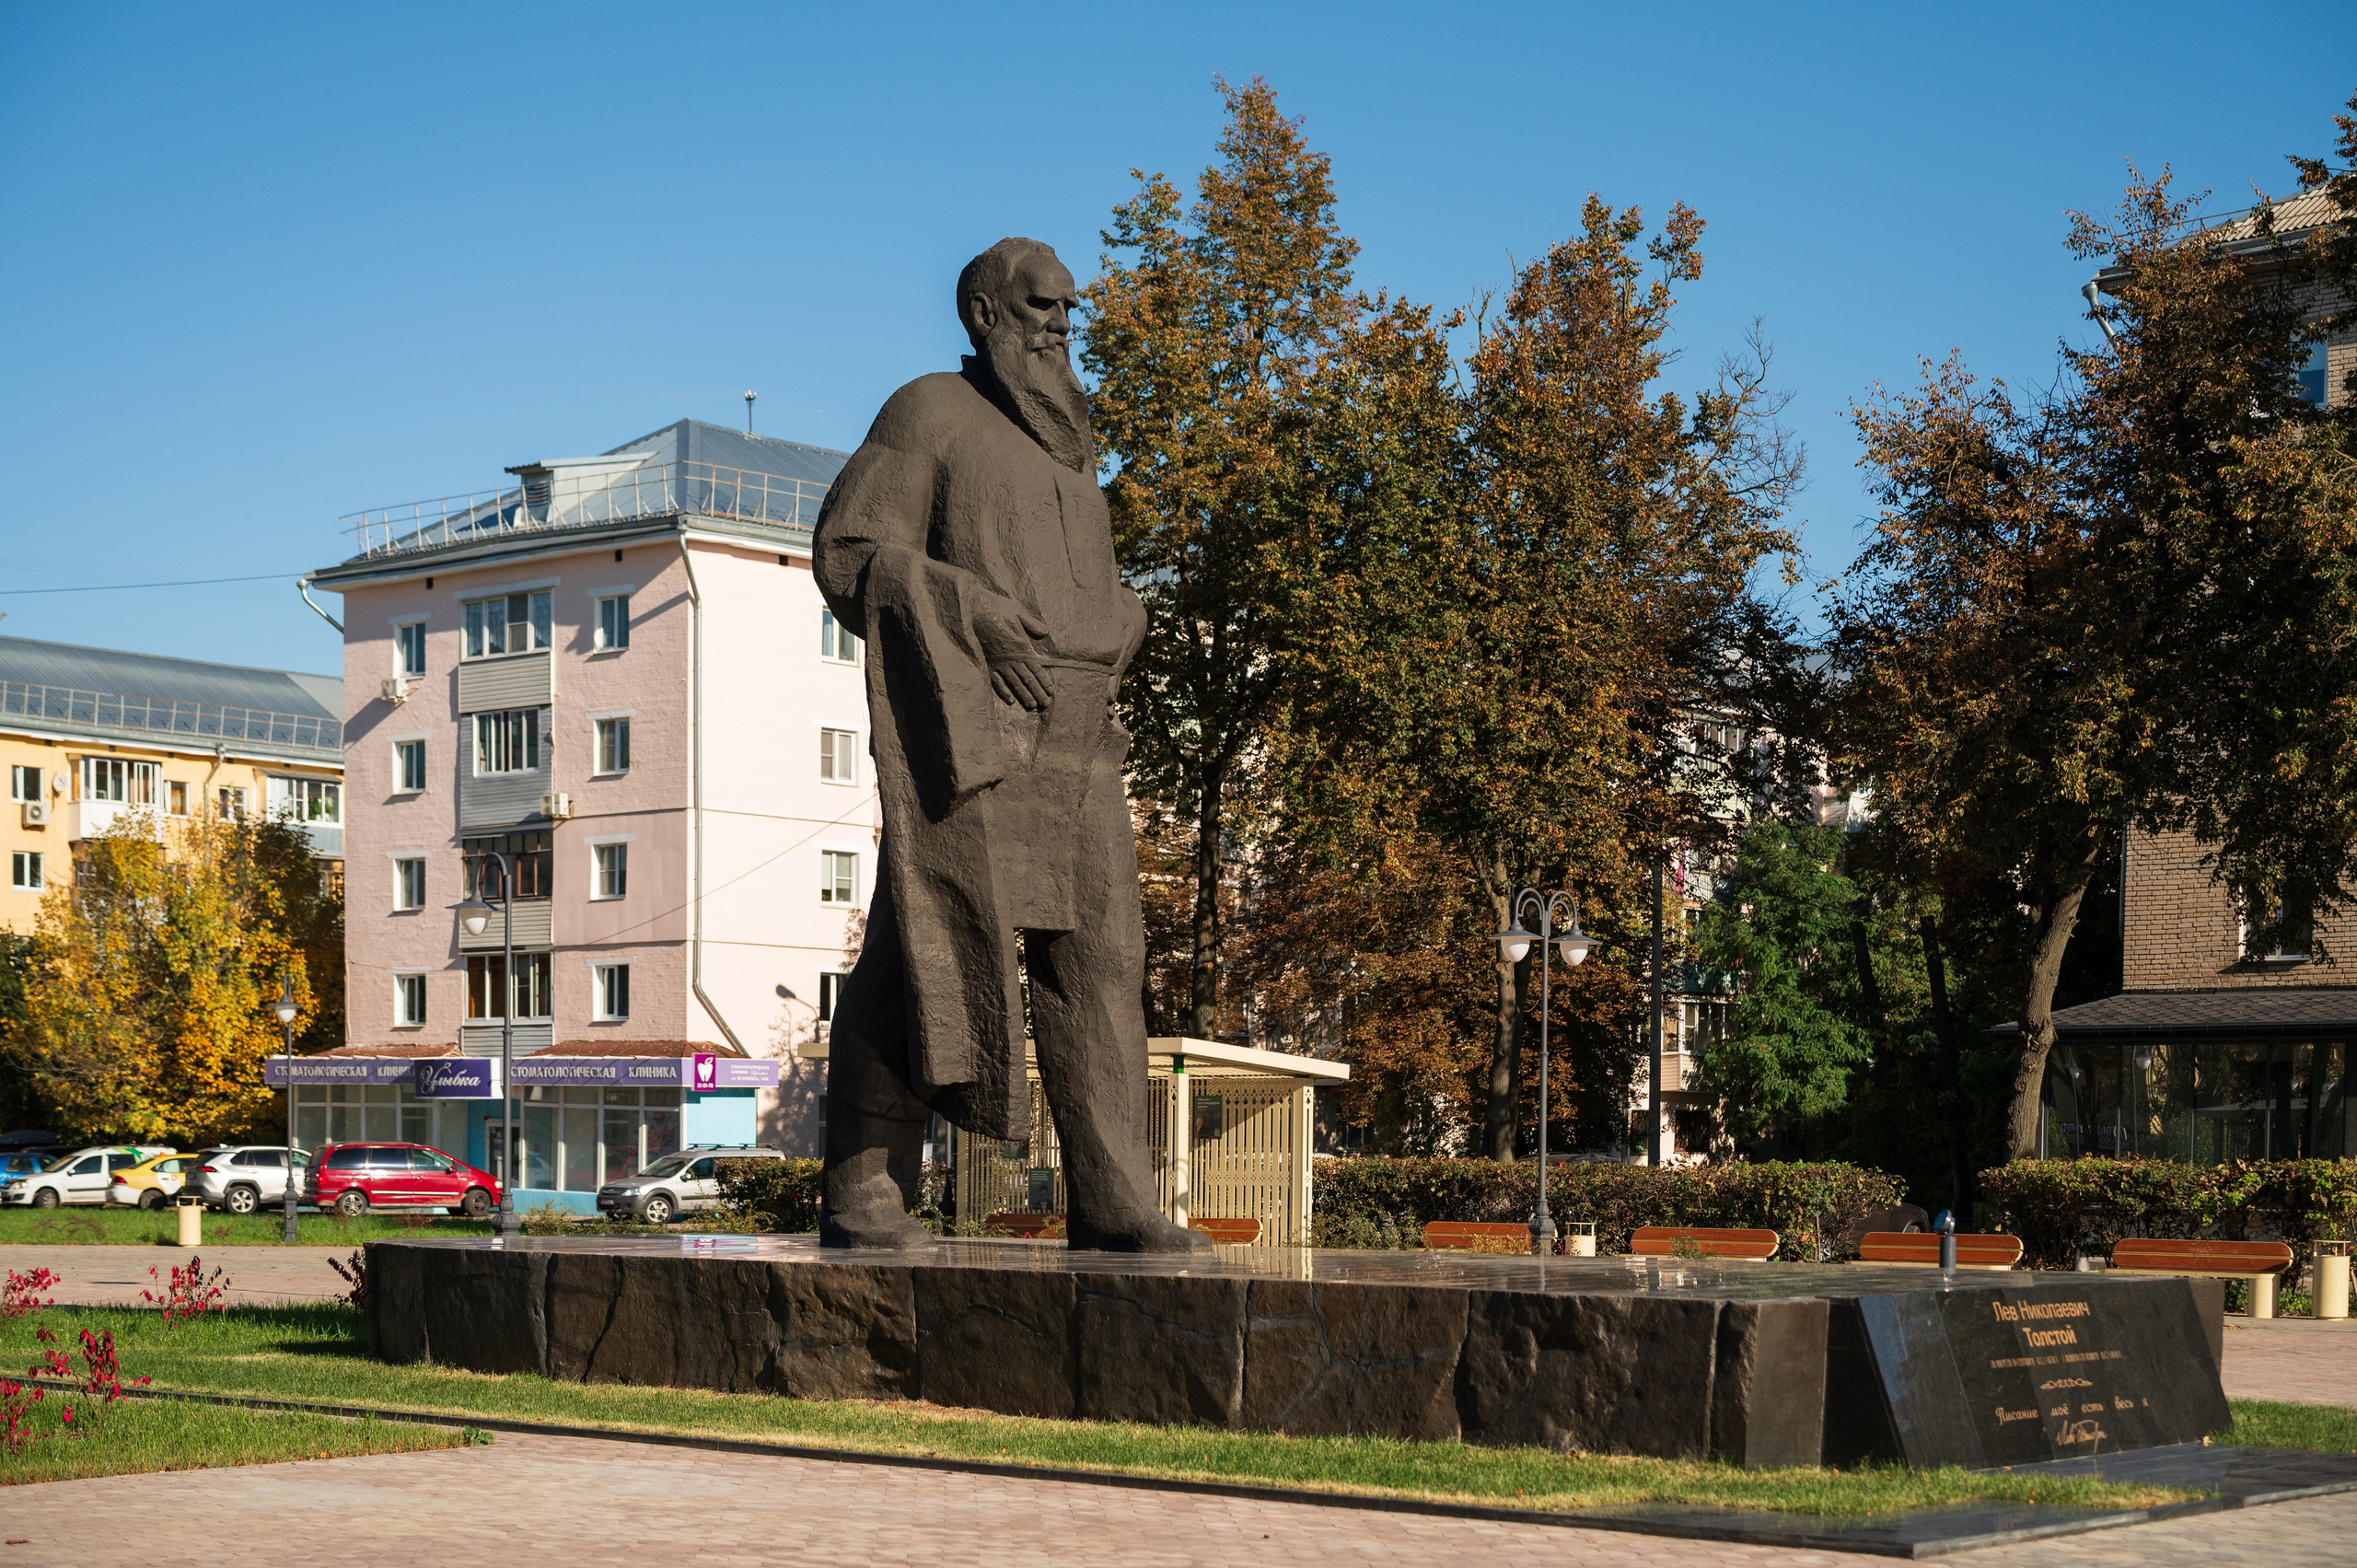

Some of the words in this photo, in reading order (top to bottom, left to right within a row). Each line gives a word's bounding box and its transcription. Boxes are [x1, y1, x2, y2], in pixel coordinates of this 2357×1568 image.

[420, 1062, 482, 1094] Улыбка
[510, 1066, 616, 1078] СТОМАТОЛОГИЧЕСКАЯ
[628, 1066, 678, 1079] КЛИНИКА
[1992, 1301, 2019, 1322] Лев
[2017, 1300, 2091, 1320] Николаевич
[2022, 1324, 2078, 1348] Толстой
[1994, 1407, 2038, 1426] Писание
[2050, 1403, 2070, 1417] моё
[2081, 1401, 2105, 1413] есть
[2114, 1396, 2134, 1410] весь
[2142, 1397, 2149, 1408] я
